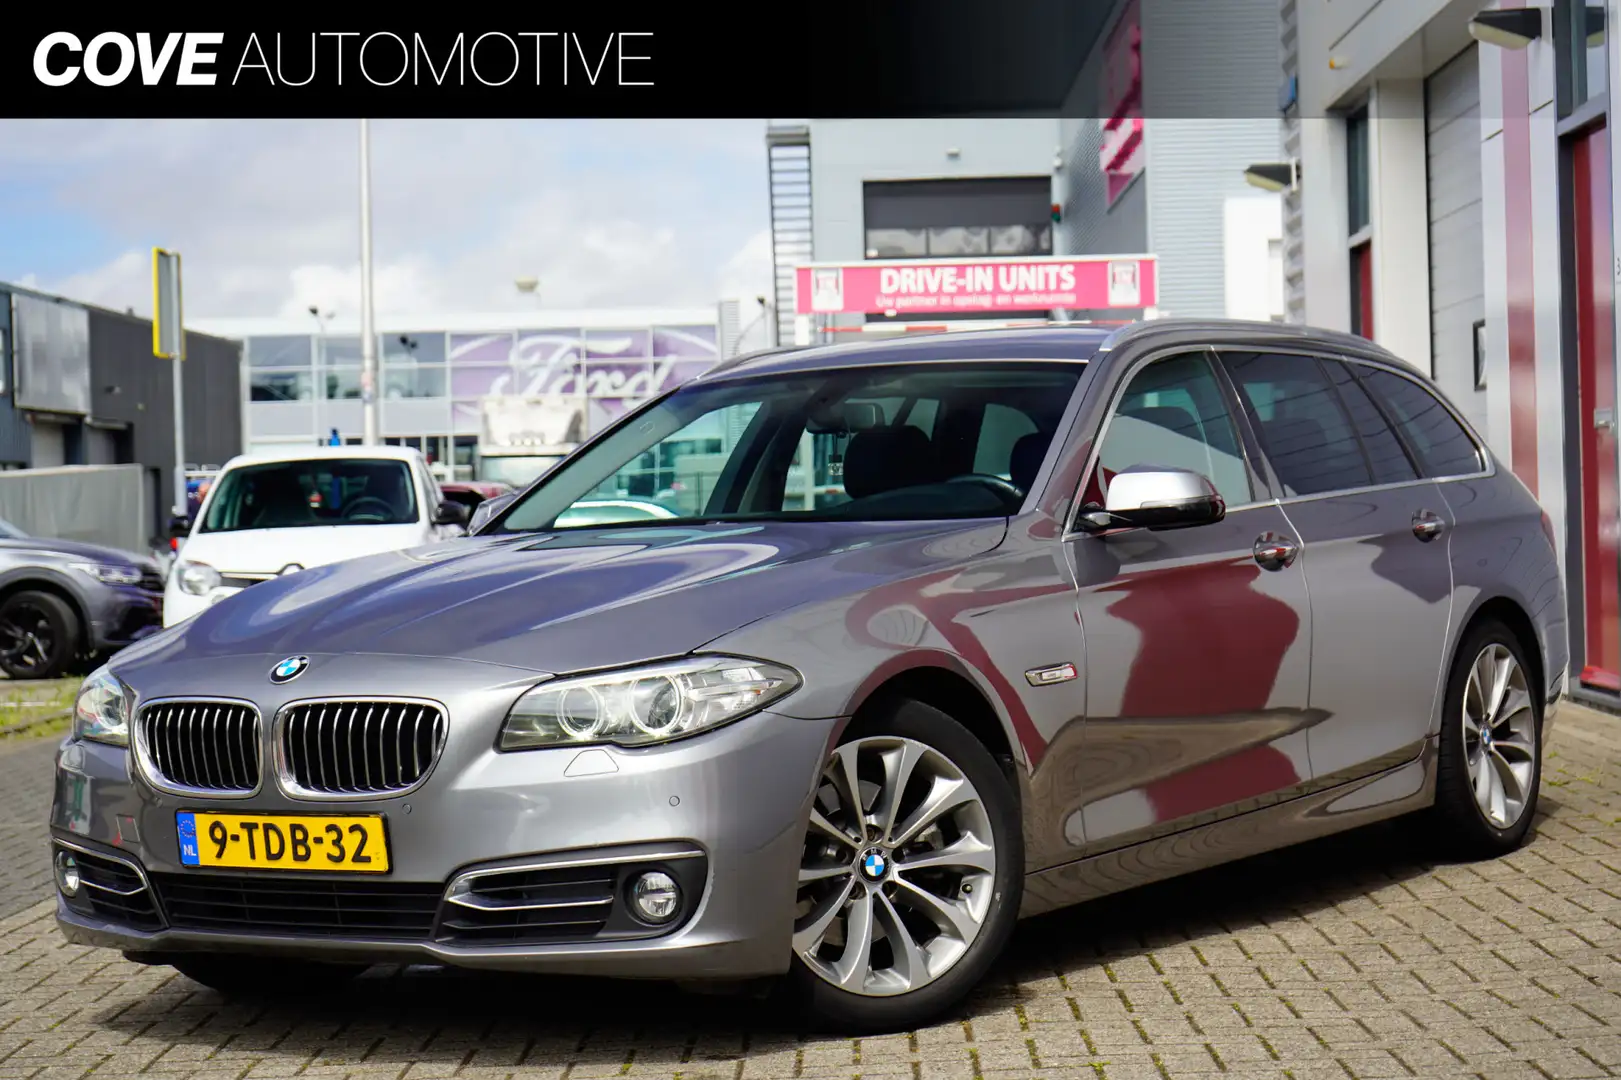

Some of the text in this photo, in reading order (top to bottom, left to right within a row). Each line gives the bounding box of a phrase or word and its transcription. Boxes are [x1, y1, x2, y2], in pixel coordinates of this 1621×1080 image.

[880, 265, 1076, 293] DRIVE-IN UNITS
[489, 335, 679, 400] Ford
[183, 845, 197, 857] NL
[208, 820, 372, 863] 9-TDB-32
